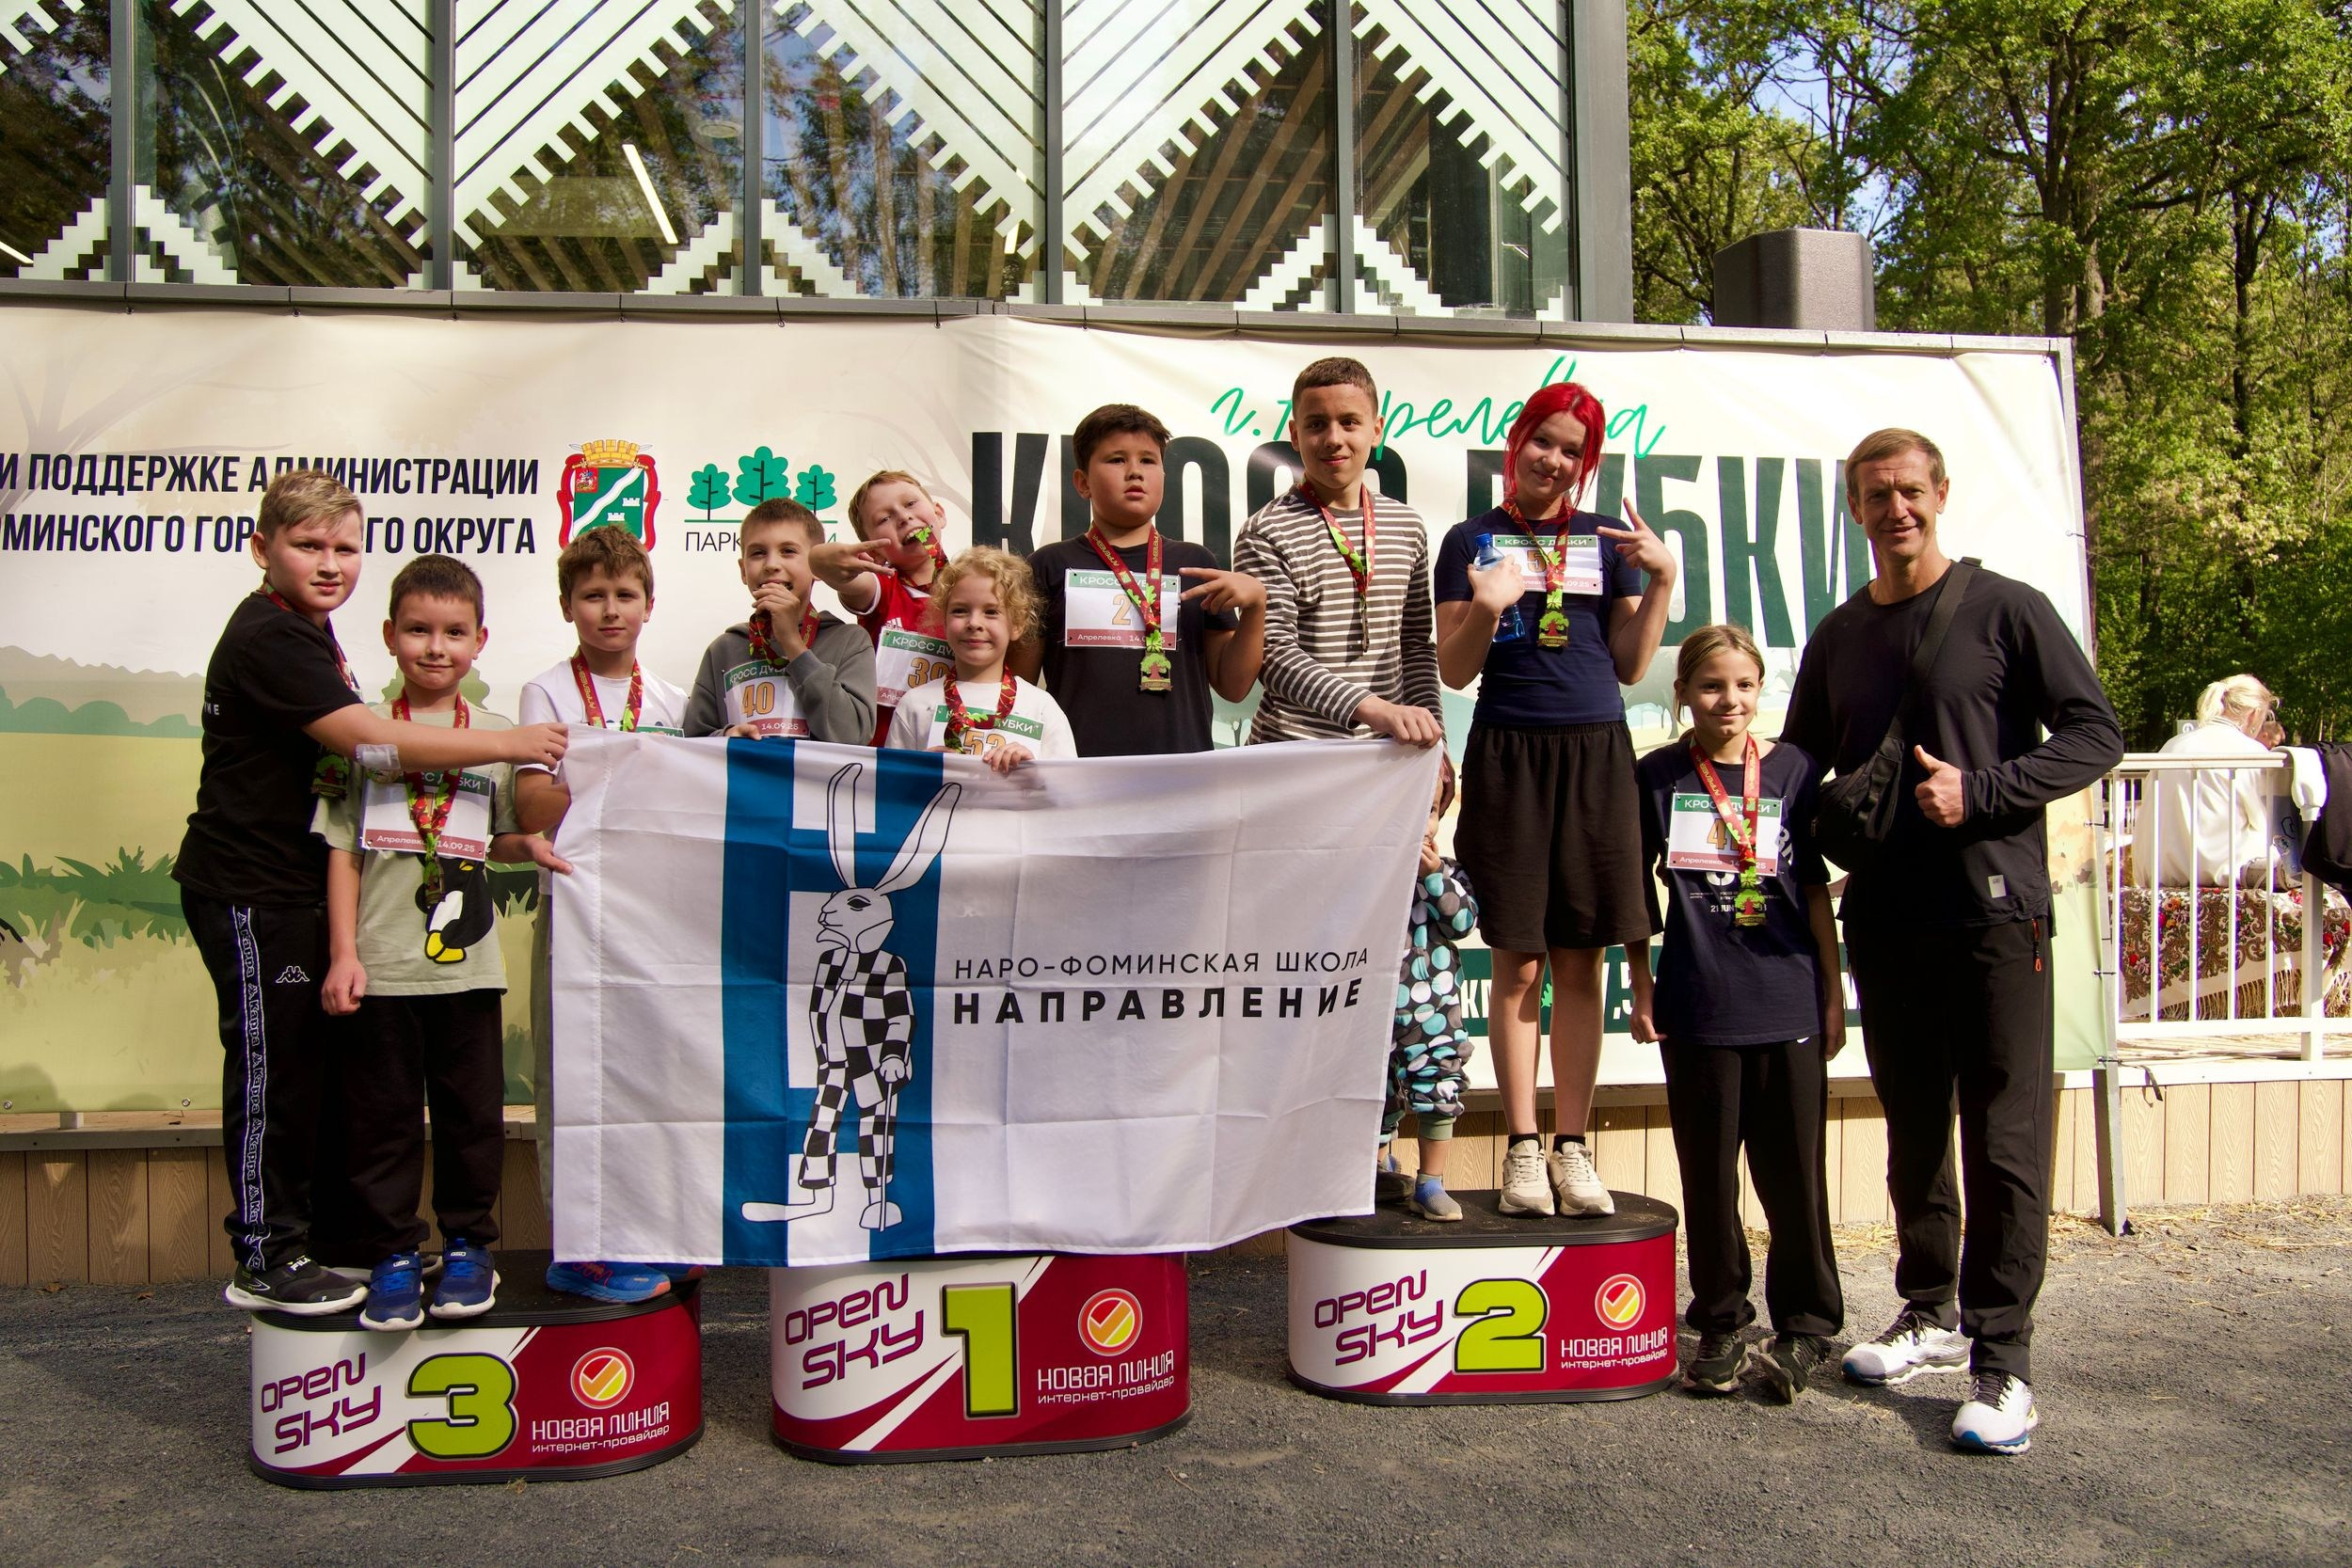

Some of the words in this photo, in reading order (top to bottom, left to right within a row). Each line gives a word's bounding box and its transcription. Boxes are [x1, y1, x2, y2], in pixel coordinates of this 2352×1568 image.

[28, 453, 241, 496] ПОДДЕРЖКЕ
[194, 515, 405, 553] ГОРГО
[413, 517, 536, 554] ОКРУГА
[685, 531, 741, 552] ПАРК
[892, 636, 935, 651] КРОСС
[729, 667, 757, 685] КРОСС
[742, 682, 775, 718] 40
[998, 719, 1034, 734] УБКИ
[1684, 800, 1717, 809] КРОС
[1731, 801, 1771, 813] ДУКИ
[437, 840, 475, 852] 14.09.25
[240, 928, 255, 977] Kappa
[955, 952, 1259, 979] НАРО-ФОМИНСКАЯ
[1276, 947, 1369, 973] ШКОЛА
[953, 977, 1362, 1024] НАПРАВЛЕНИЕ
[249, 999, 261, 1046] Kappa
[249, 1067, 263, 1115] Kappa
[246, 1132, 260, 1180] Kappa
[290, 1256, 311, 1272] FILA
[1452, 1276, 1550, 1375] 2
[1561, 1338, 1622, 1358] НОВАЯ
[1627, 1325, 1668, 1355] ЛИНИЯ
[941, 1281, 1021, 1420] 1
[1561, 1348, 1668, 1370] интернет-провайдер
[1038, 1364, 1113, 1391] НОВАЯ
[1119, 1350, 1174, 1386] ЛИНИЯ
[405, 1352, 520, 1463] 3
[1038, 1375, 1175, 1404] интернет-провайдер
[532, 1416, 604, 1442] НОВАЯ
[609, 1401, 670, 1438] ЛИНИЯ
[532, 1424, 670, 1454] интернет-провайдер
